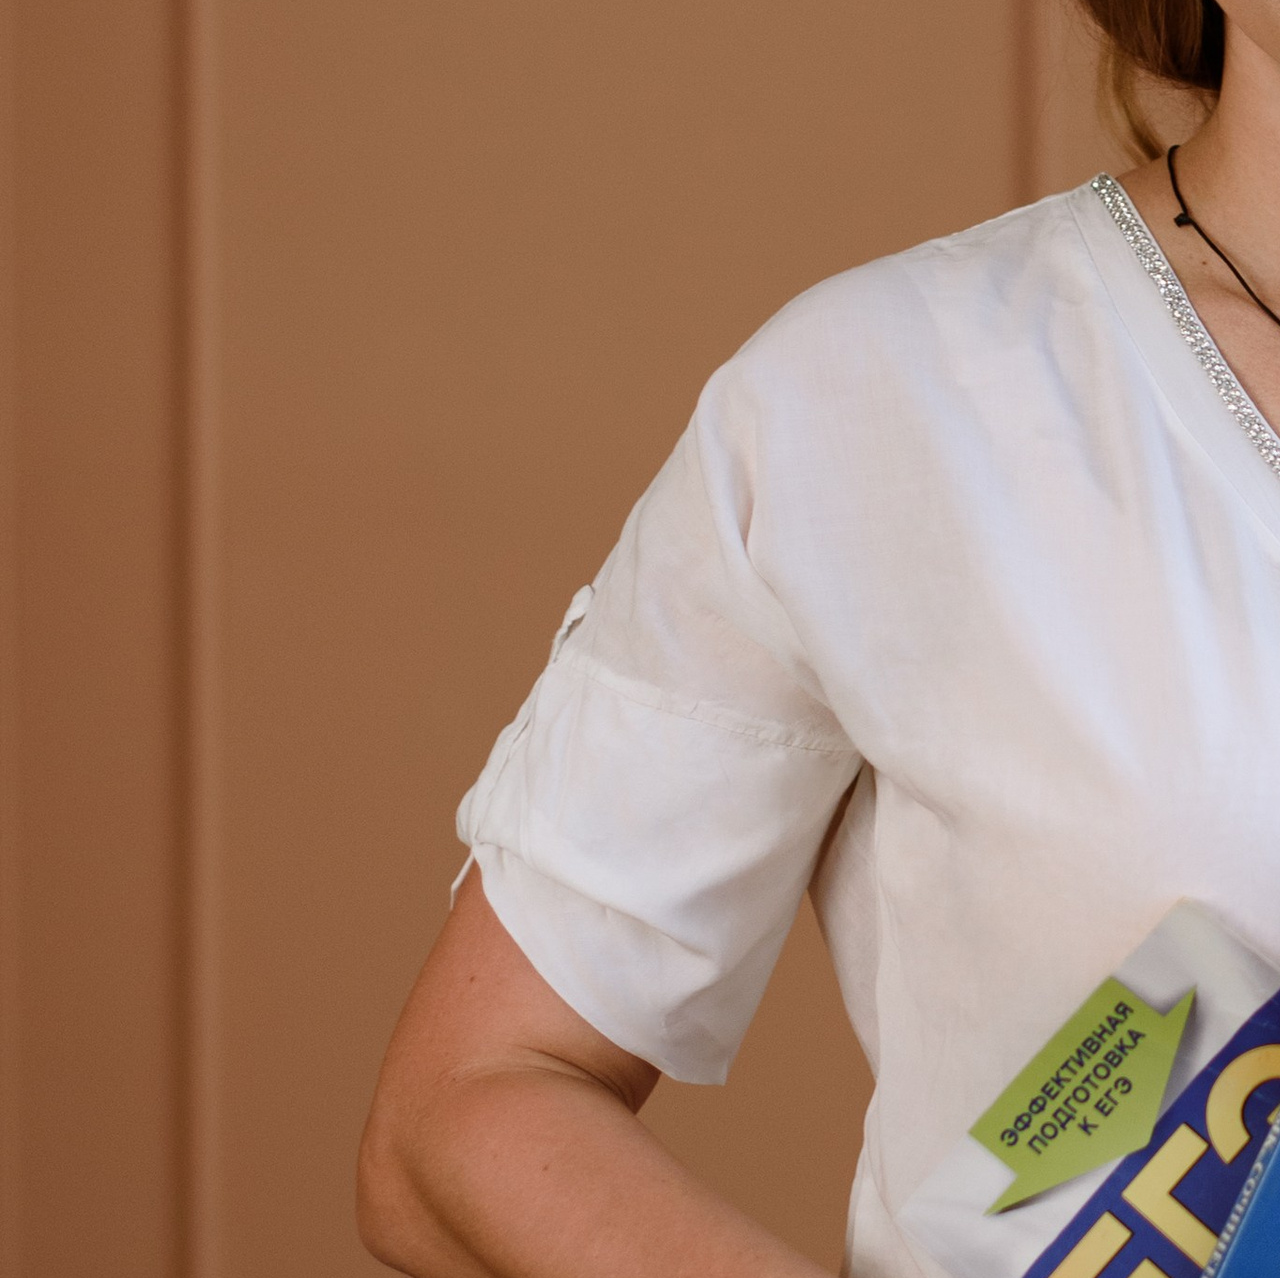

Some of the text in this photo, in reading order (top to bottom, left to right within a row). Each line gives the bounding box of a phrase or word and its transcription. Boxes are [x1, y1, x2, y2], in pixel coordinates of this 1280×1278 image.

[1000, 1001, 1134, 1147] ЭФФЕКТИВНАЯ
[1027, 1028, 1146, 1155] ПОДГОТОВКА
[1077, 1076, 1133, 1137] К ЕГЭ
